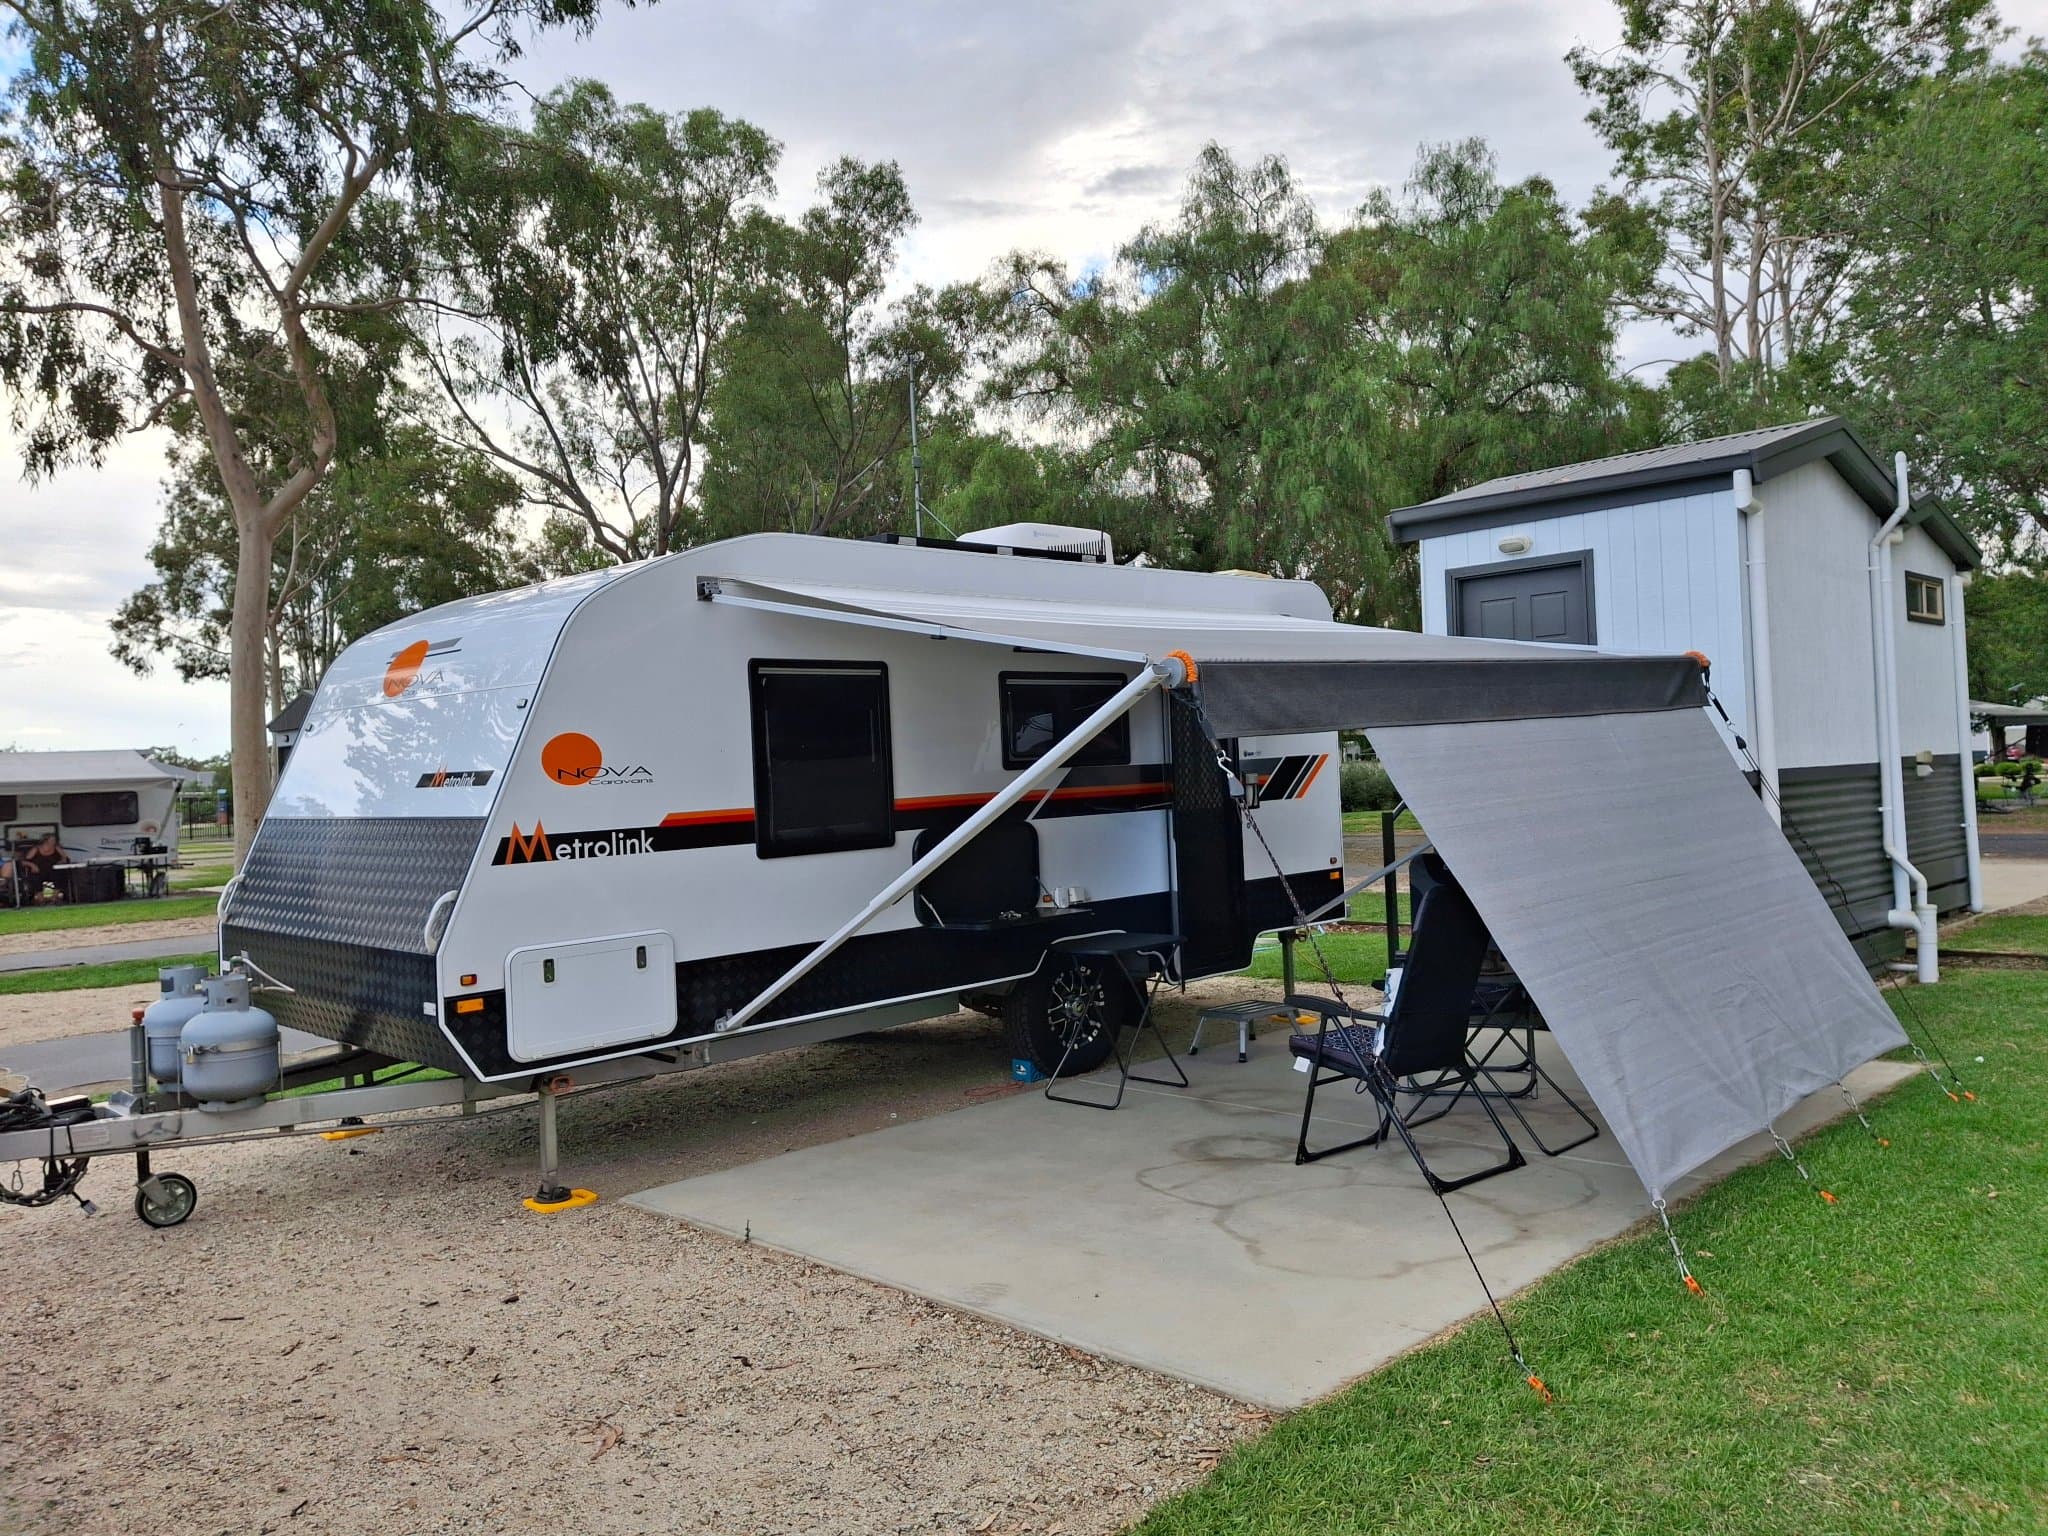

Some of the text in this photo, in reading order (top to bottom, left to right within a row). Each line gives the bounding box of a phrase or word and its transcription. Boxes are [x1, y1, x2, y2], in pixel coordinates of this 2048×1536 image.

[387, 669, 444, 690] NOVA
[429, 762, 476, 789] Metrolink
[557, 765, 653, 780] NOVA
[588, 778, 654, 786] Caravans
[504, 816, 656, 865] Metrolink
